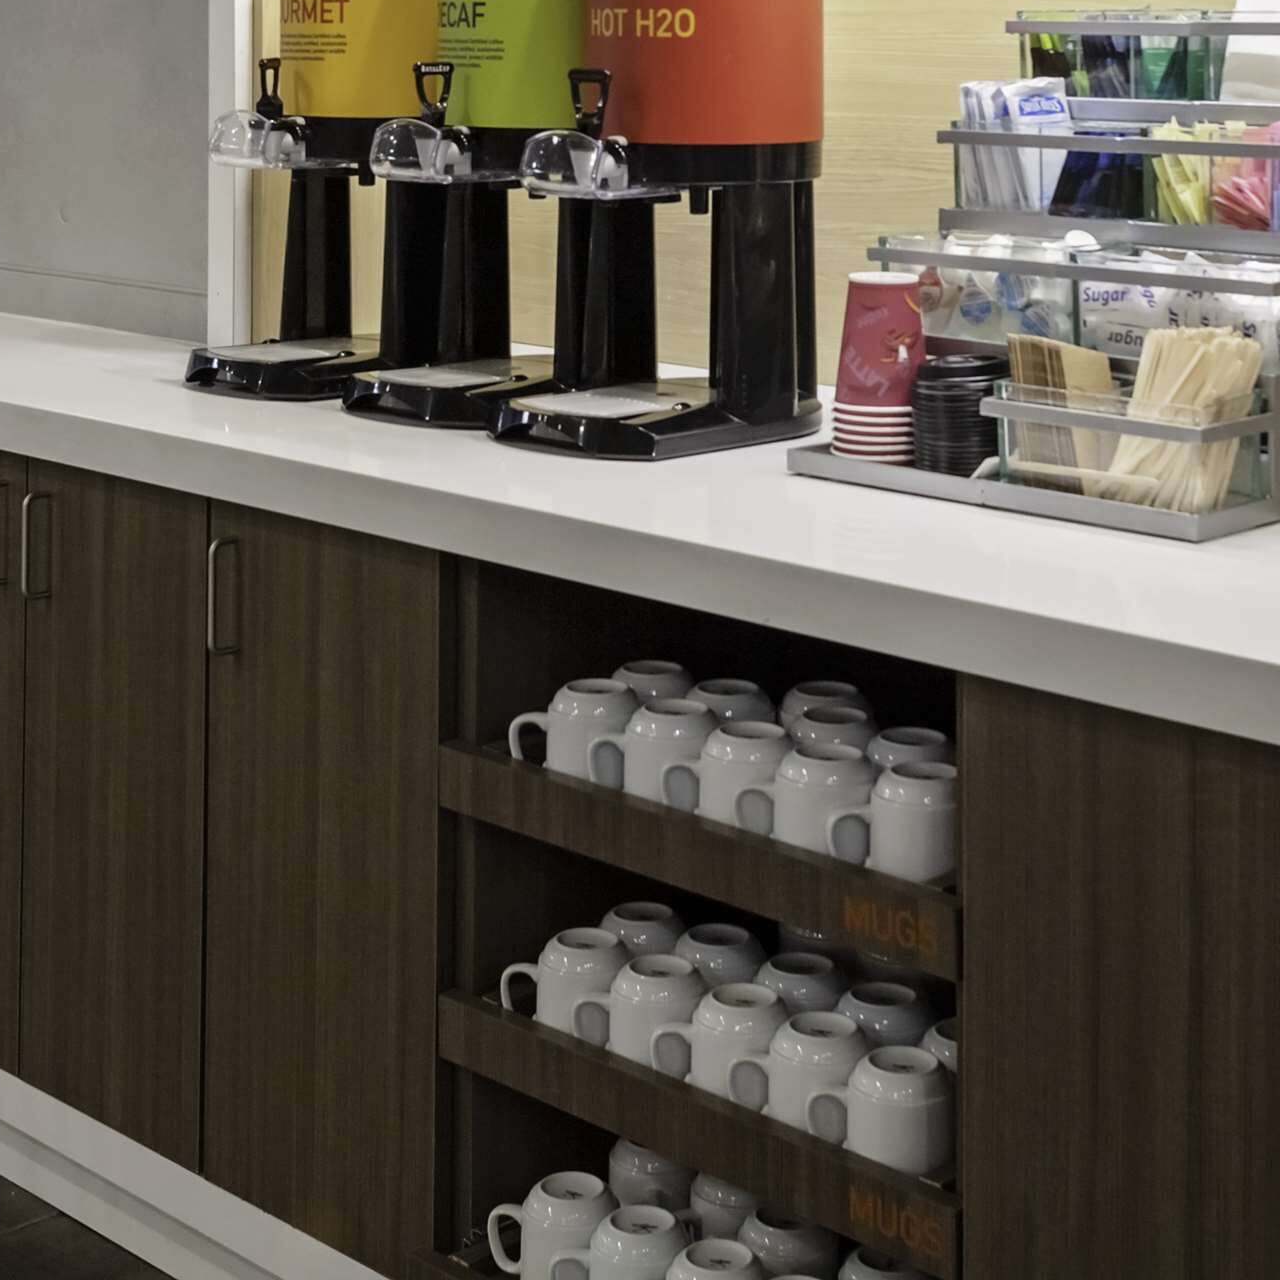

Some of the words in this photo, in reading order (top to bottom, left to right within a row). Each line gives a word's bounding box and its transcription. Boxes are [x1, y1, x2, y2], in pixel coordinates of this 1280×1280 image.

[280, 0, 350, 24] URMET
[437, 1, 486, 28] ECAF
[591, 8, 628, 37] HOT
[636, 8, 696, 37] H2O
[1083, 287, 1128, 306] Sugar
[1107, 329, 1144, 348] ugar
[842, 895, 938, 956] MUGS
[848, 1185, 945, 1258] MUGS
